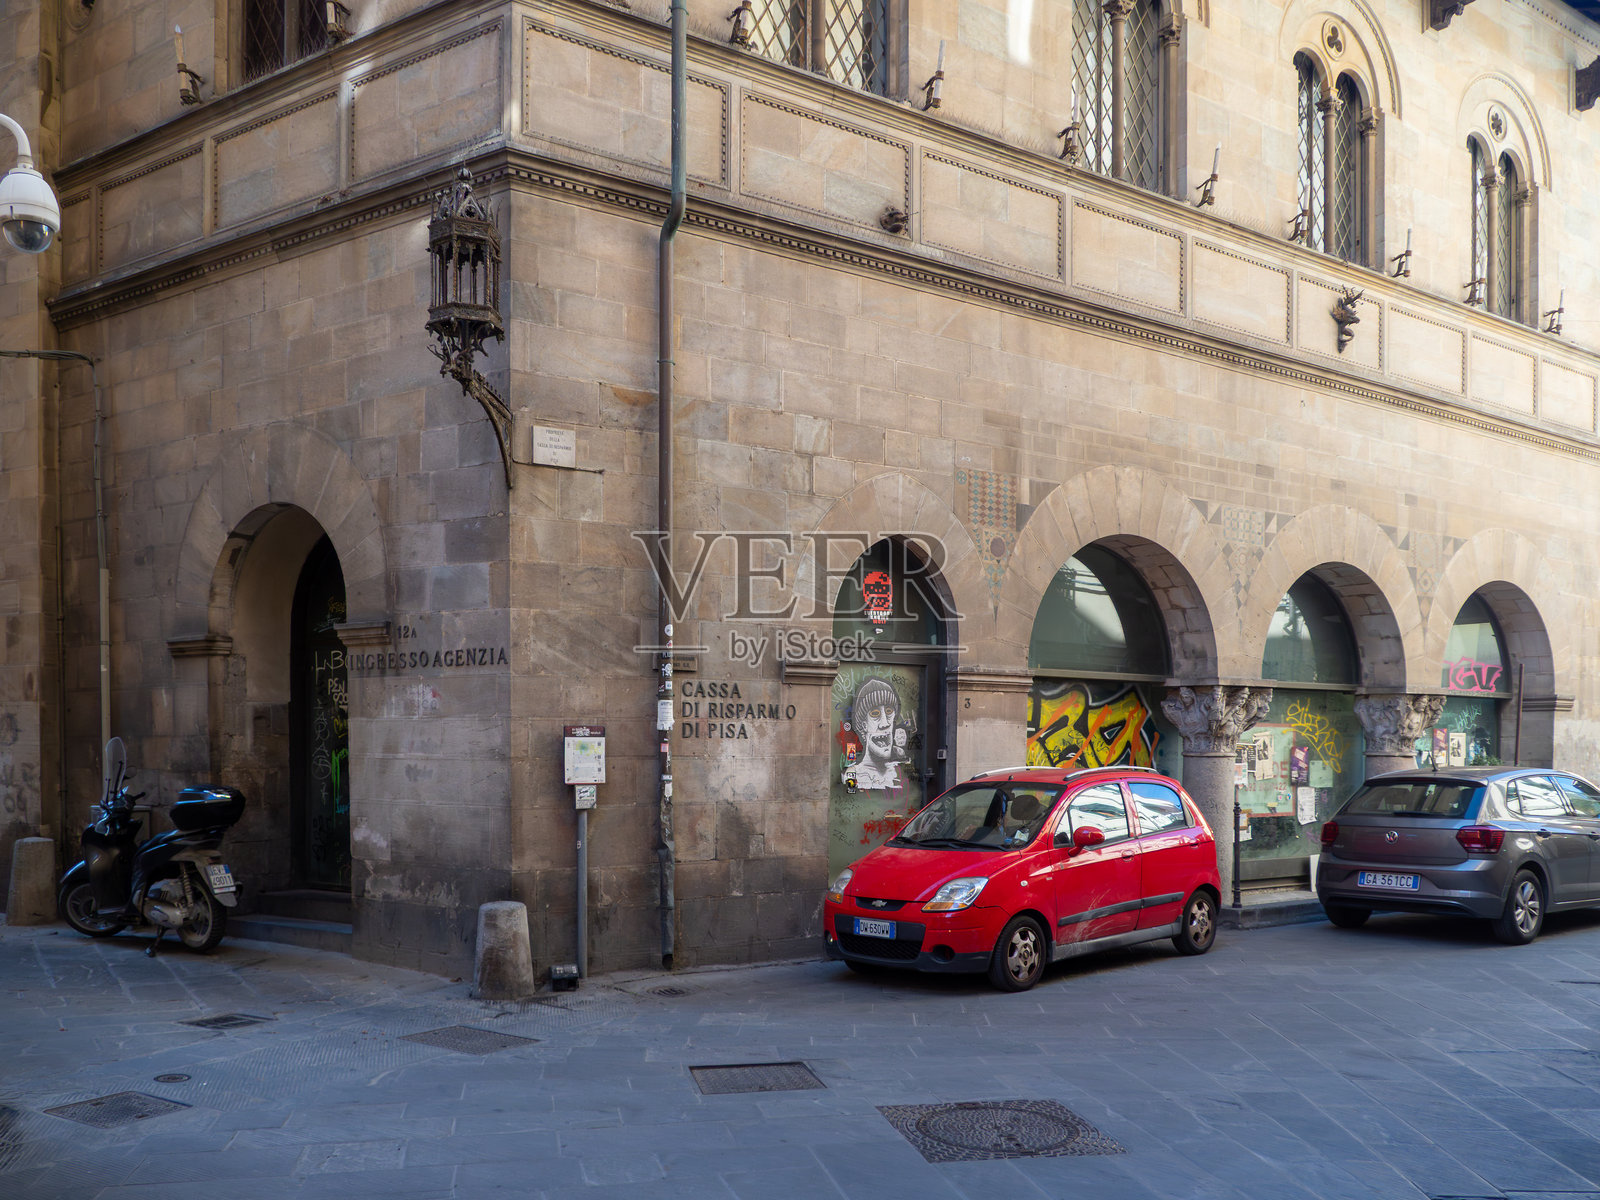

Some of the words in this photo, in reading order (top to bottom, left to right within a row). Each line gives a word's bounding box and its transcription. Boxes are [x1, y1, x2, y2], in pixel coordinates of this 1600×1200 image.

[397, 625, 417, 639] 12A
[350, 651, 429, 671] INGRESSO
[432, 647, 509, 668] AGENZIA
[682, 681, 742, 699] CASSA
[682, 702, 700, 718] DI
[708, 702, 797, 720] RISPARMO
[964, 697, 971, 709] 3
[682, 722, 700, 739] DI
[708, 723, 748, 740] PISA
